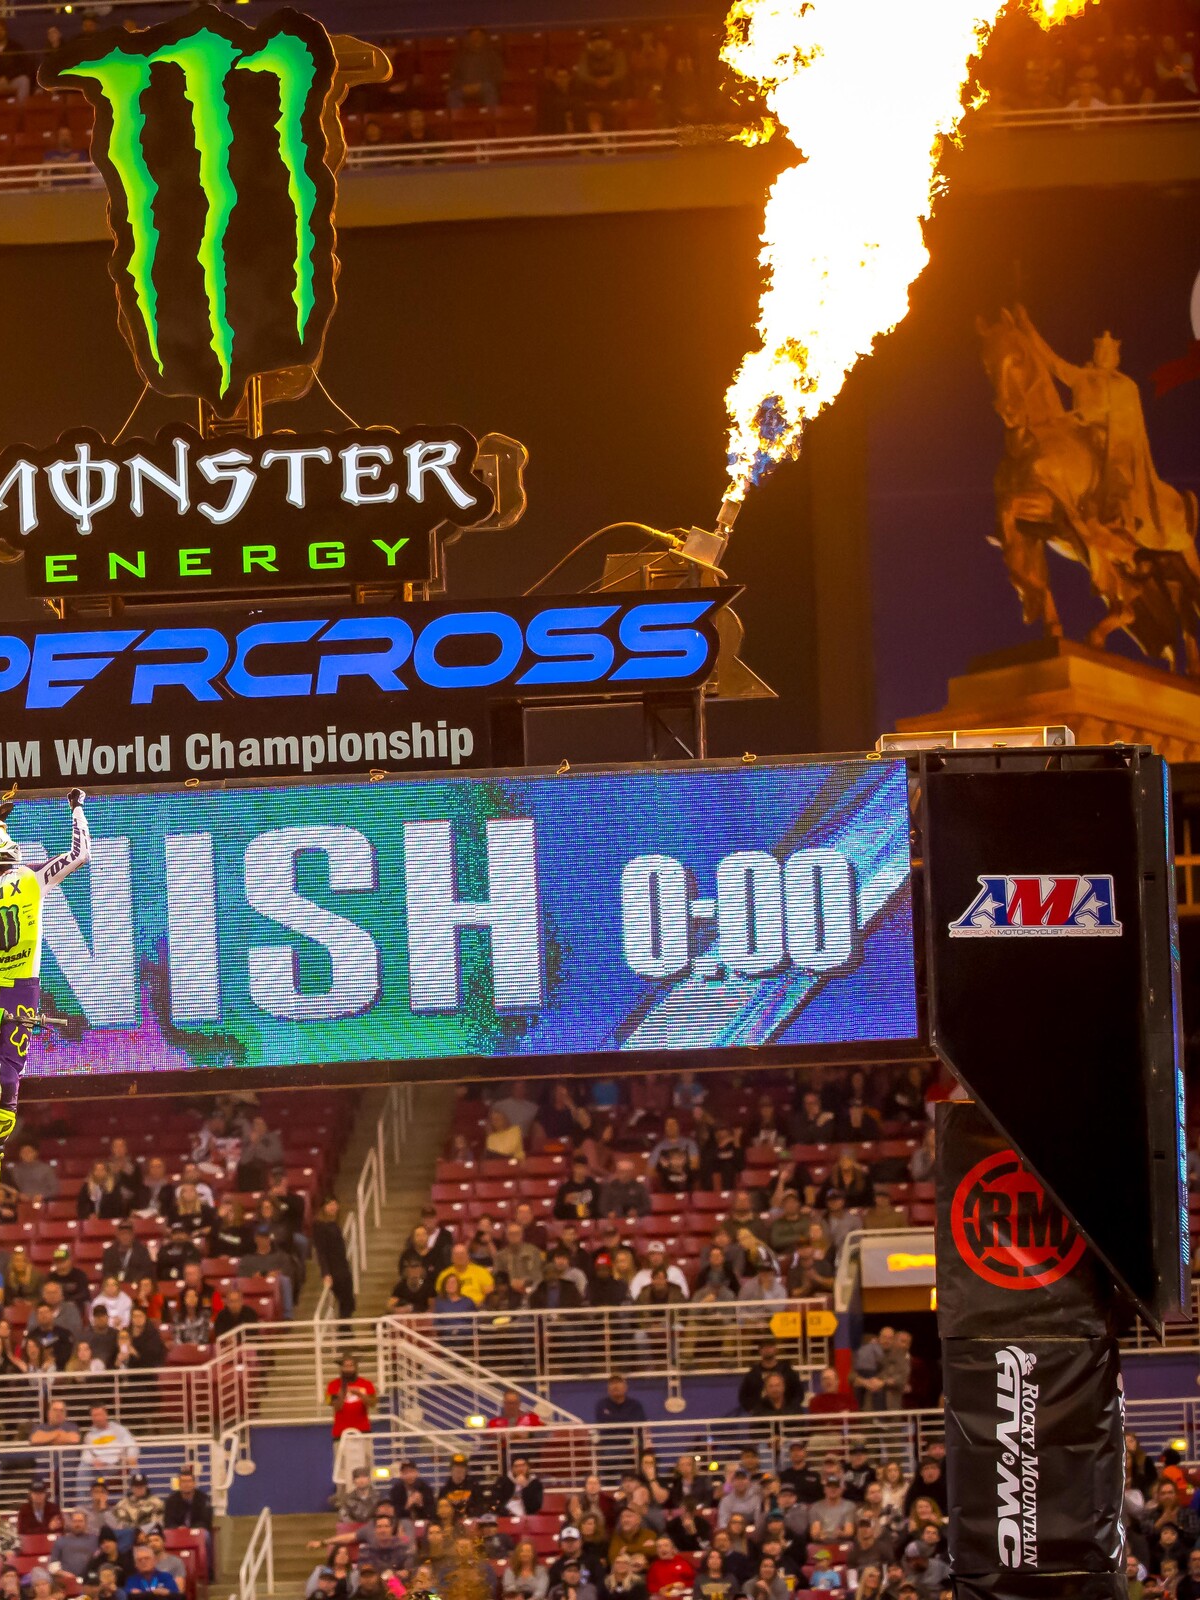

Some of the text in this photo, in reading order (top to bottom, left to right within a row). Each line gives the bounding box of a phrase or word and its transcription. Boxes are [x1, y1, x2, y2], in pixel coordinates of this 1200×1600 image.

[45, 537, 410, 583] ENERGY
[54, 735, 171, 776] World
[185, 719, 475, 774] Championship
[44, 855, 71, 885] FOX
[951, 876, 1121, 928] AMA
[979, 1191, 1063, 1247] RM
[1019, 1379, 1039, 1568] ROCKY MOUNTAIN
